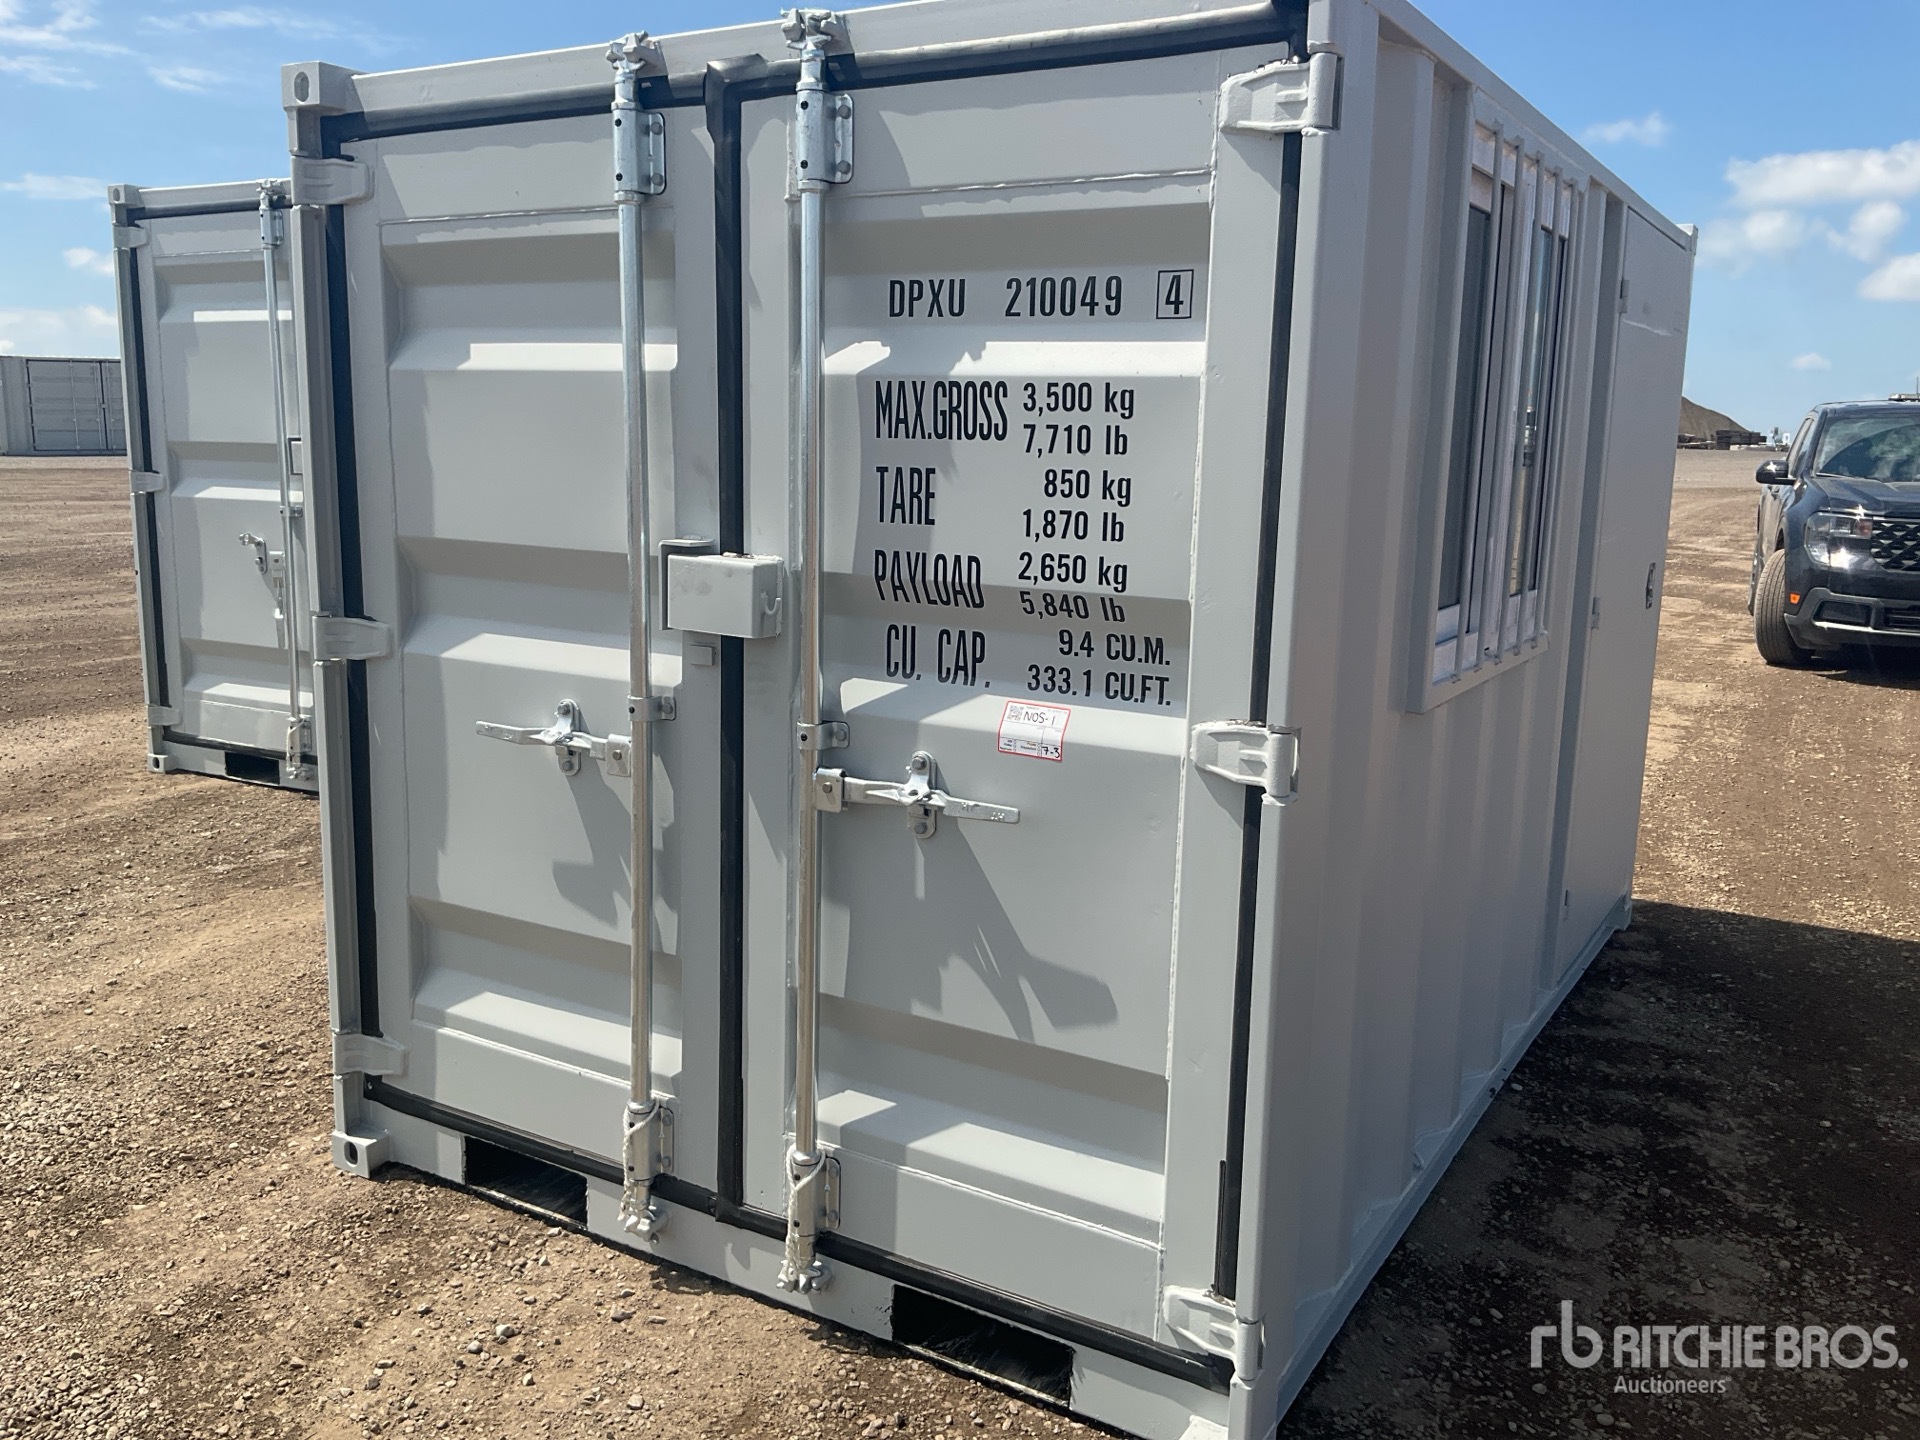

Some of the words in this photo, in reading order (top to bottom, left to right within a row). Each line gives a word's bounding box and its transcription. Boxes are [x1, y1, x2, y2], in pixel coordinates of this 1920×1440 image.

[889, 278, 966, 317] DPXU
[1004, 275, 1123, 317] 210049
[1164, 274, 1184, 315] 4
[875, 380, 1008, 441] MAX.GROSS
[1022, 382, 1092, 416] 3,500
[1104, 382, 1135, 419] kg
[1023, 424, 1091, 458] 7,710
[1105, 425, 1128, 455] lb
[876, 466, 936, 526] TARE
[1043, 469, 1090, 499] 850
[1101, 470, 1132, 507] kg
[1022, 509, 1089, 543] 1,870
[1102, 511, 1125, 542] lb
[874, 549, 985, 609] PAYLOAD
[1018, 552, 1087, 586] 2,650
[1097, 556, 1128, 593] kg
[1019, 591, 1090, 620] 5,840
[1099, 597, 1126, 623] lb
[886, 624, 922, 681] CU.
[937, 629, 991, 688] CAP.
[1058, 630, 1095, 658] 9.4
[1106, 633, 1171, 666] CU.M.
[1027, 664, 1092, 697] 333.1
[1105, 671, 1172, 706] CU.FT.
